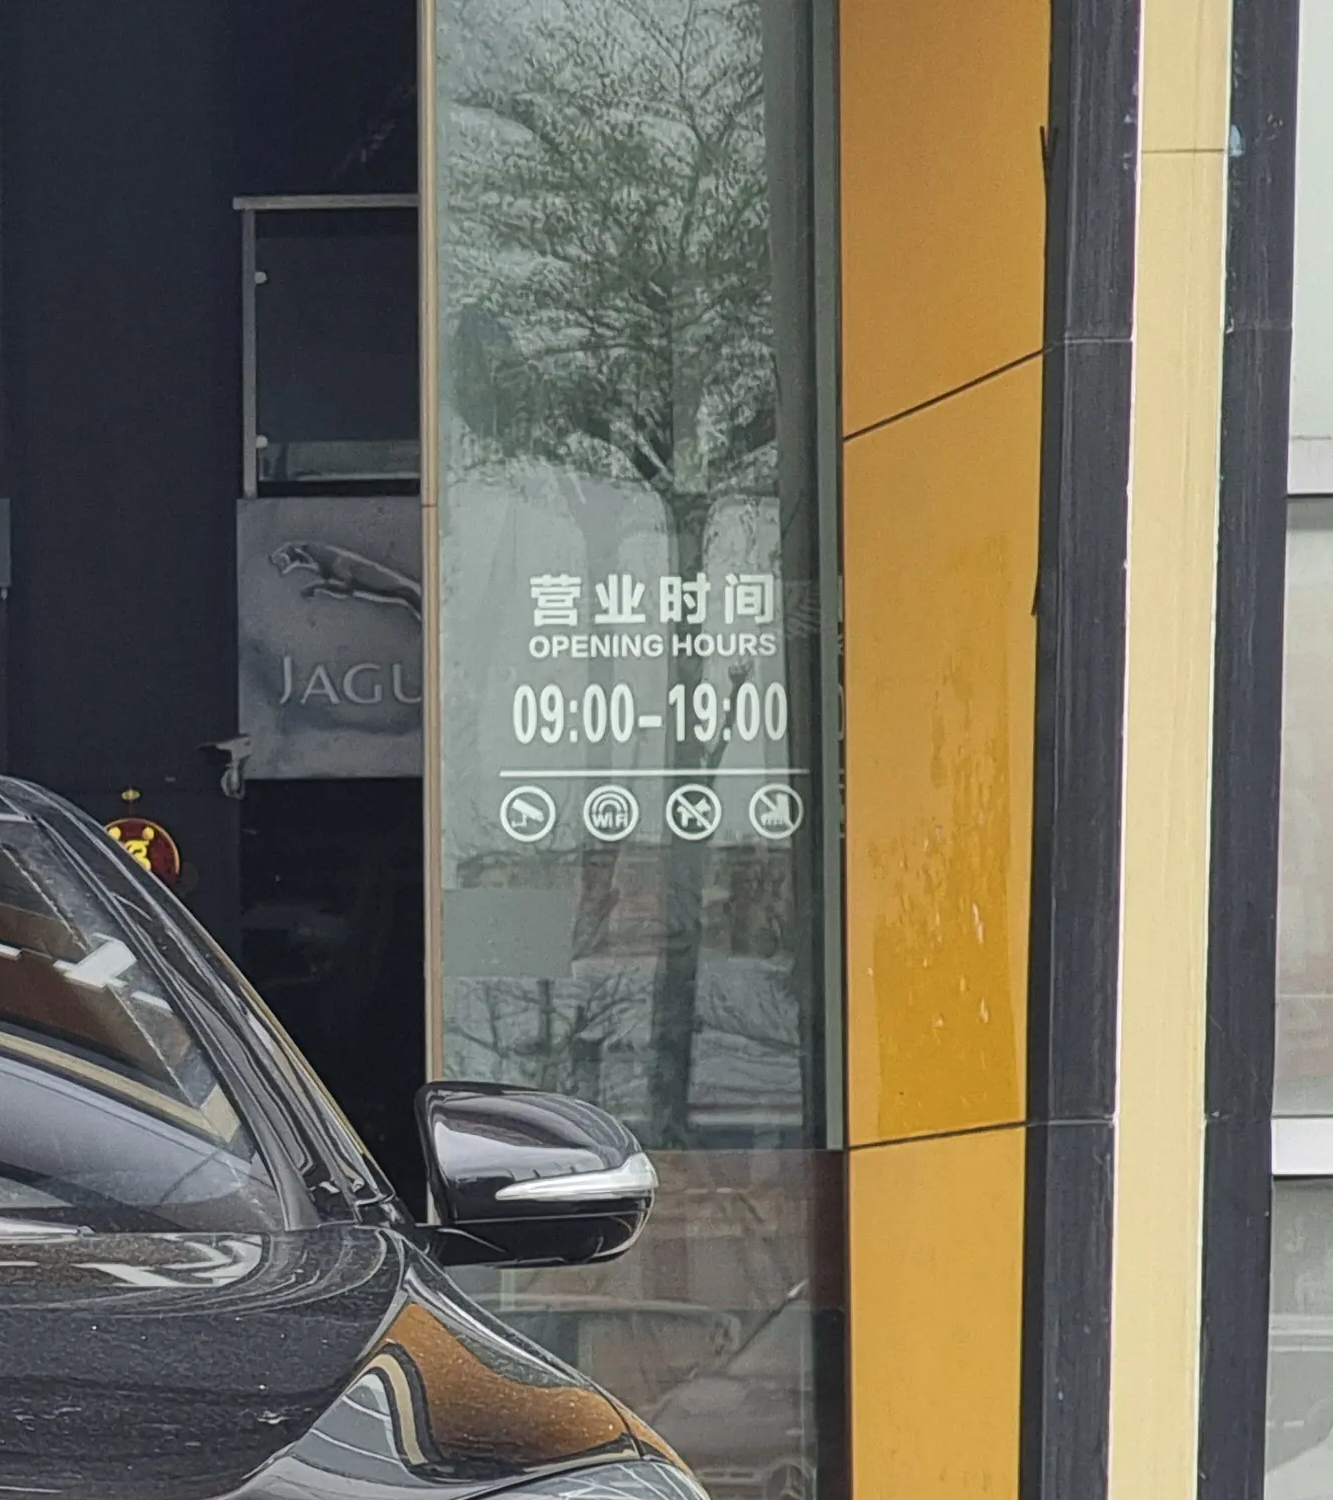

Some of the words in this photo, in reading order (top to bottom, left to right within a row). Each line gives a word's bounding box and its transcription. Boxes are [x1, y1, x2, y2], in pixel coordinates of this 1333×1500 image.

[530, 573, 773, 626] 营业时间
[529, 635, 664, 658] OPENING
[672, 633, 777, 657] HOURS
[513, 682, 787, 744] 09:00-19:00
